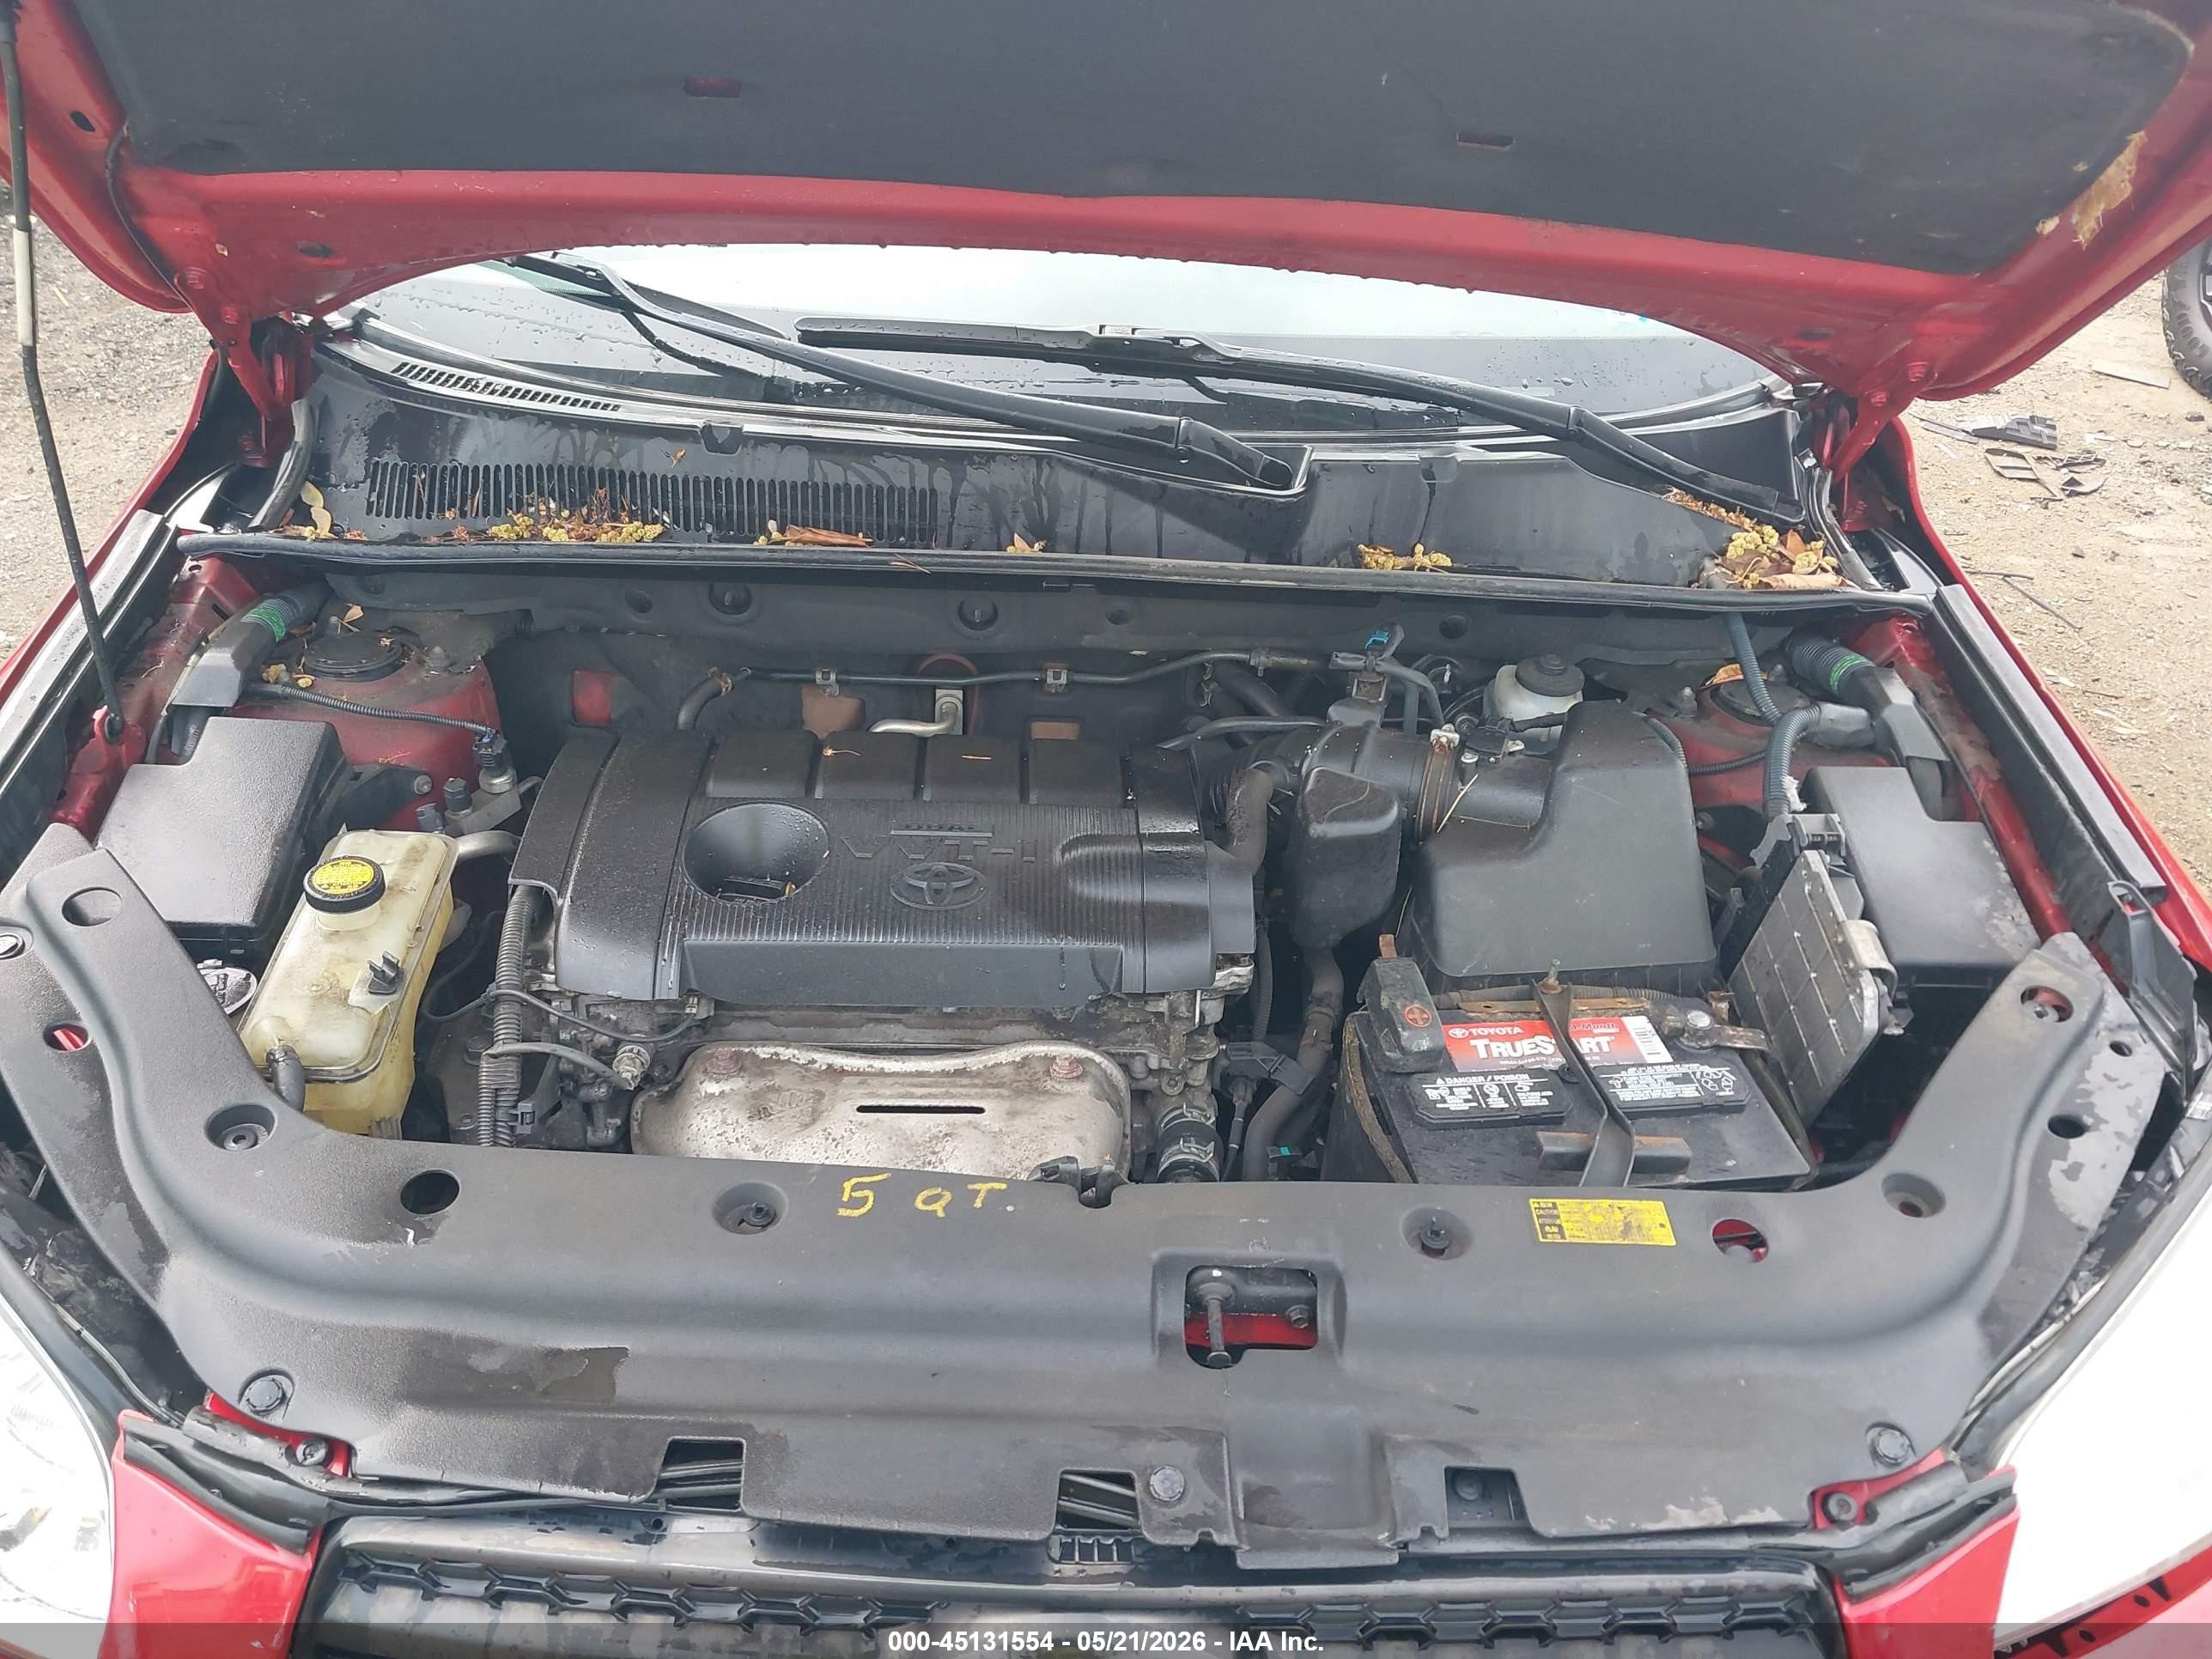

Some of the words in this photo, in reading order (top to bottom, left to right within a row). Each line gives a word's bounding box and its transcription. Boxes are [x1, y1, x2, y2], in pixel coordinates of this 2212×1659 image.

[1469, 1027, 1524, 1037] TOYOTA
[1469, 1035, 1614, 1059] TRUESRT
[1445, 1076, 1486, 1085] DANGER
[1493, 1073, 1530, 1082] POISON
[837, 1172, 892, 1218] 5
